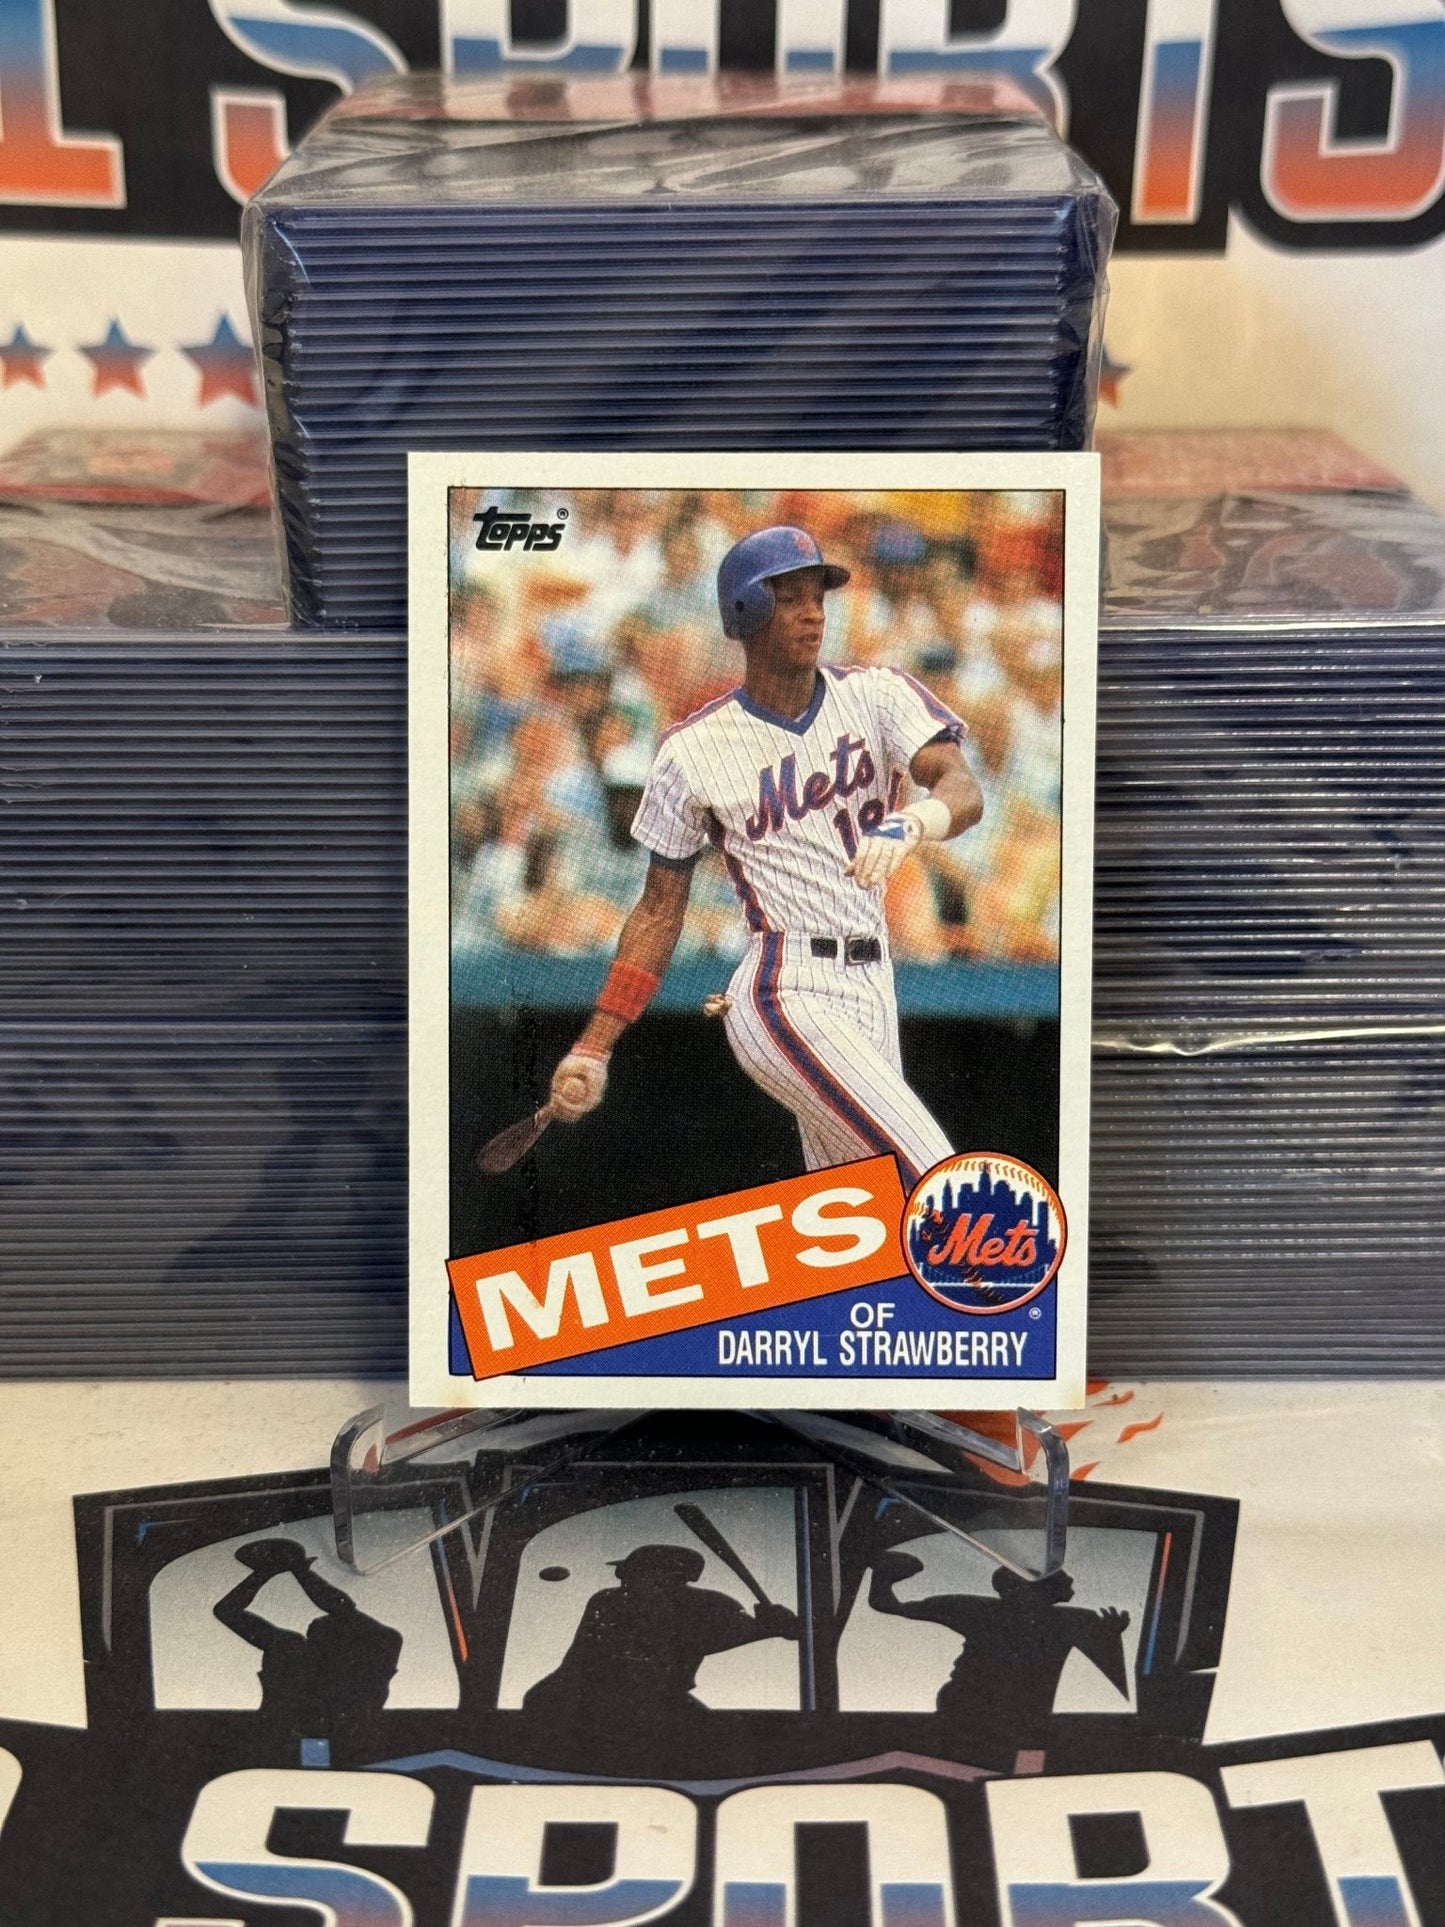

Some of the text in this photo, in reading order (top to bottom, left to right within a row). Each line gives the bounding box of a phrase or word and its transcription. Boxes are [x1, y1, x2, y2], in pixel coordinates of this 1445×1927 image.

[745, 733, 875, 841] Mets
[927, 1213, 1039, 1266] Mets
[474, 1186, 887, 1352] METS
[850, 1302, 896, 1329] OF
[718, 1330, 1028, 1367] DARRYL STRAWBERRY
